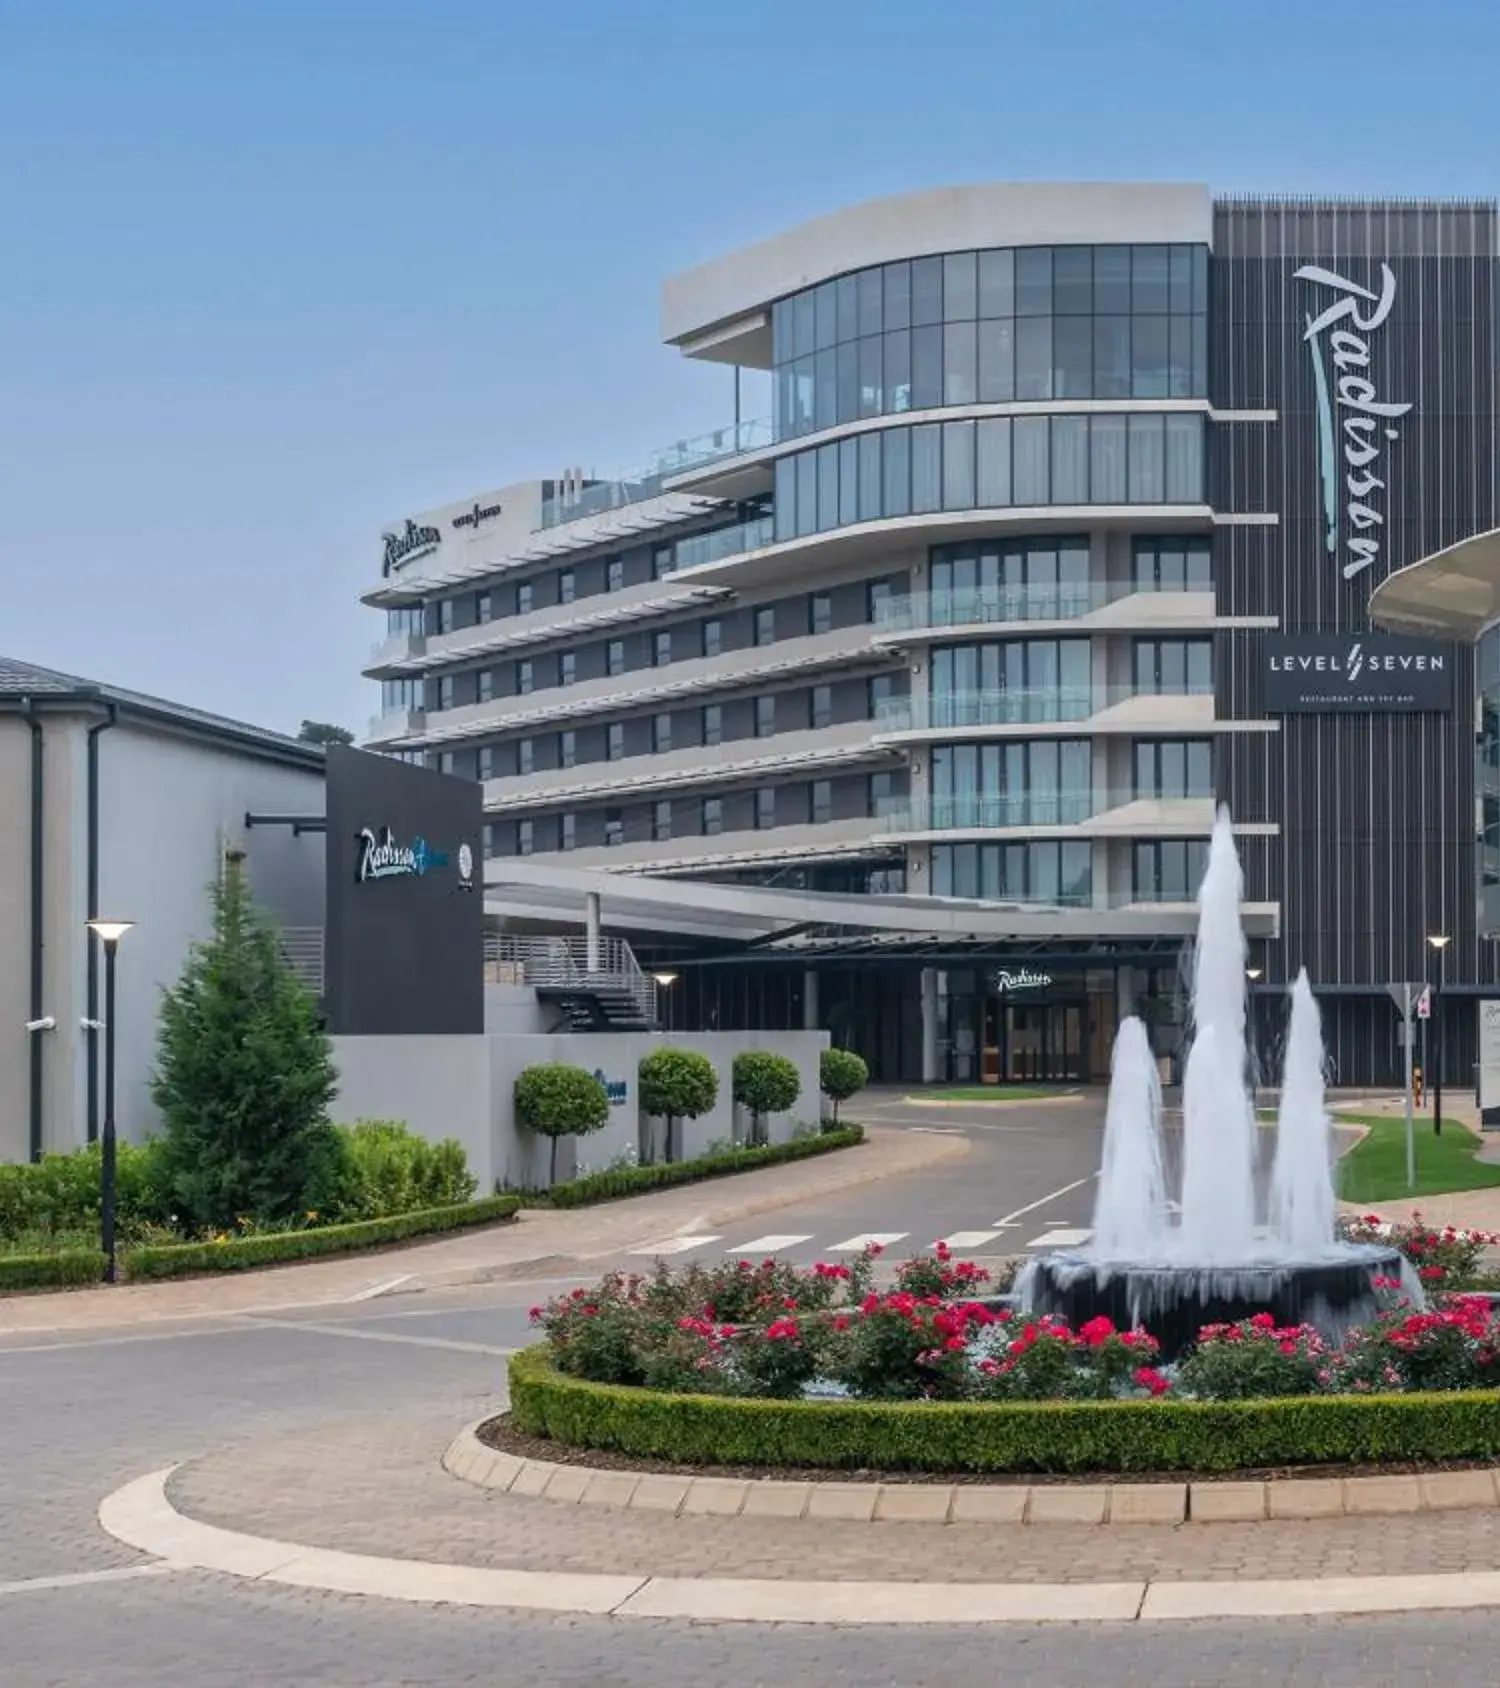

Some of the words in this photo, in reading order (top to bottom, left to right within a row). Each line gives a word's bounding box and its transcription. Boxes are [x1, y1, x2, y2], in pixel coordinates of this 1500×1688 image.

[1293, 262, 1413, 580] Radisson
[1270, 655, 1341, 671] LEVEL
[1368, 655, 1444, 671] SEVEN
[361, 825, 417, 881] Radisson
[997, 967, 1053, 993] Radisson
